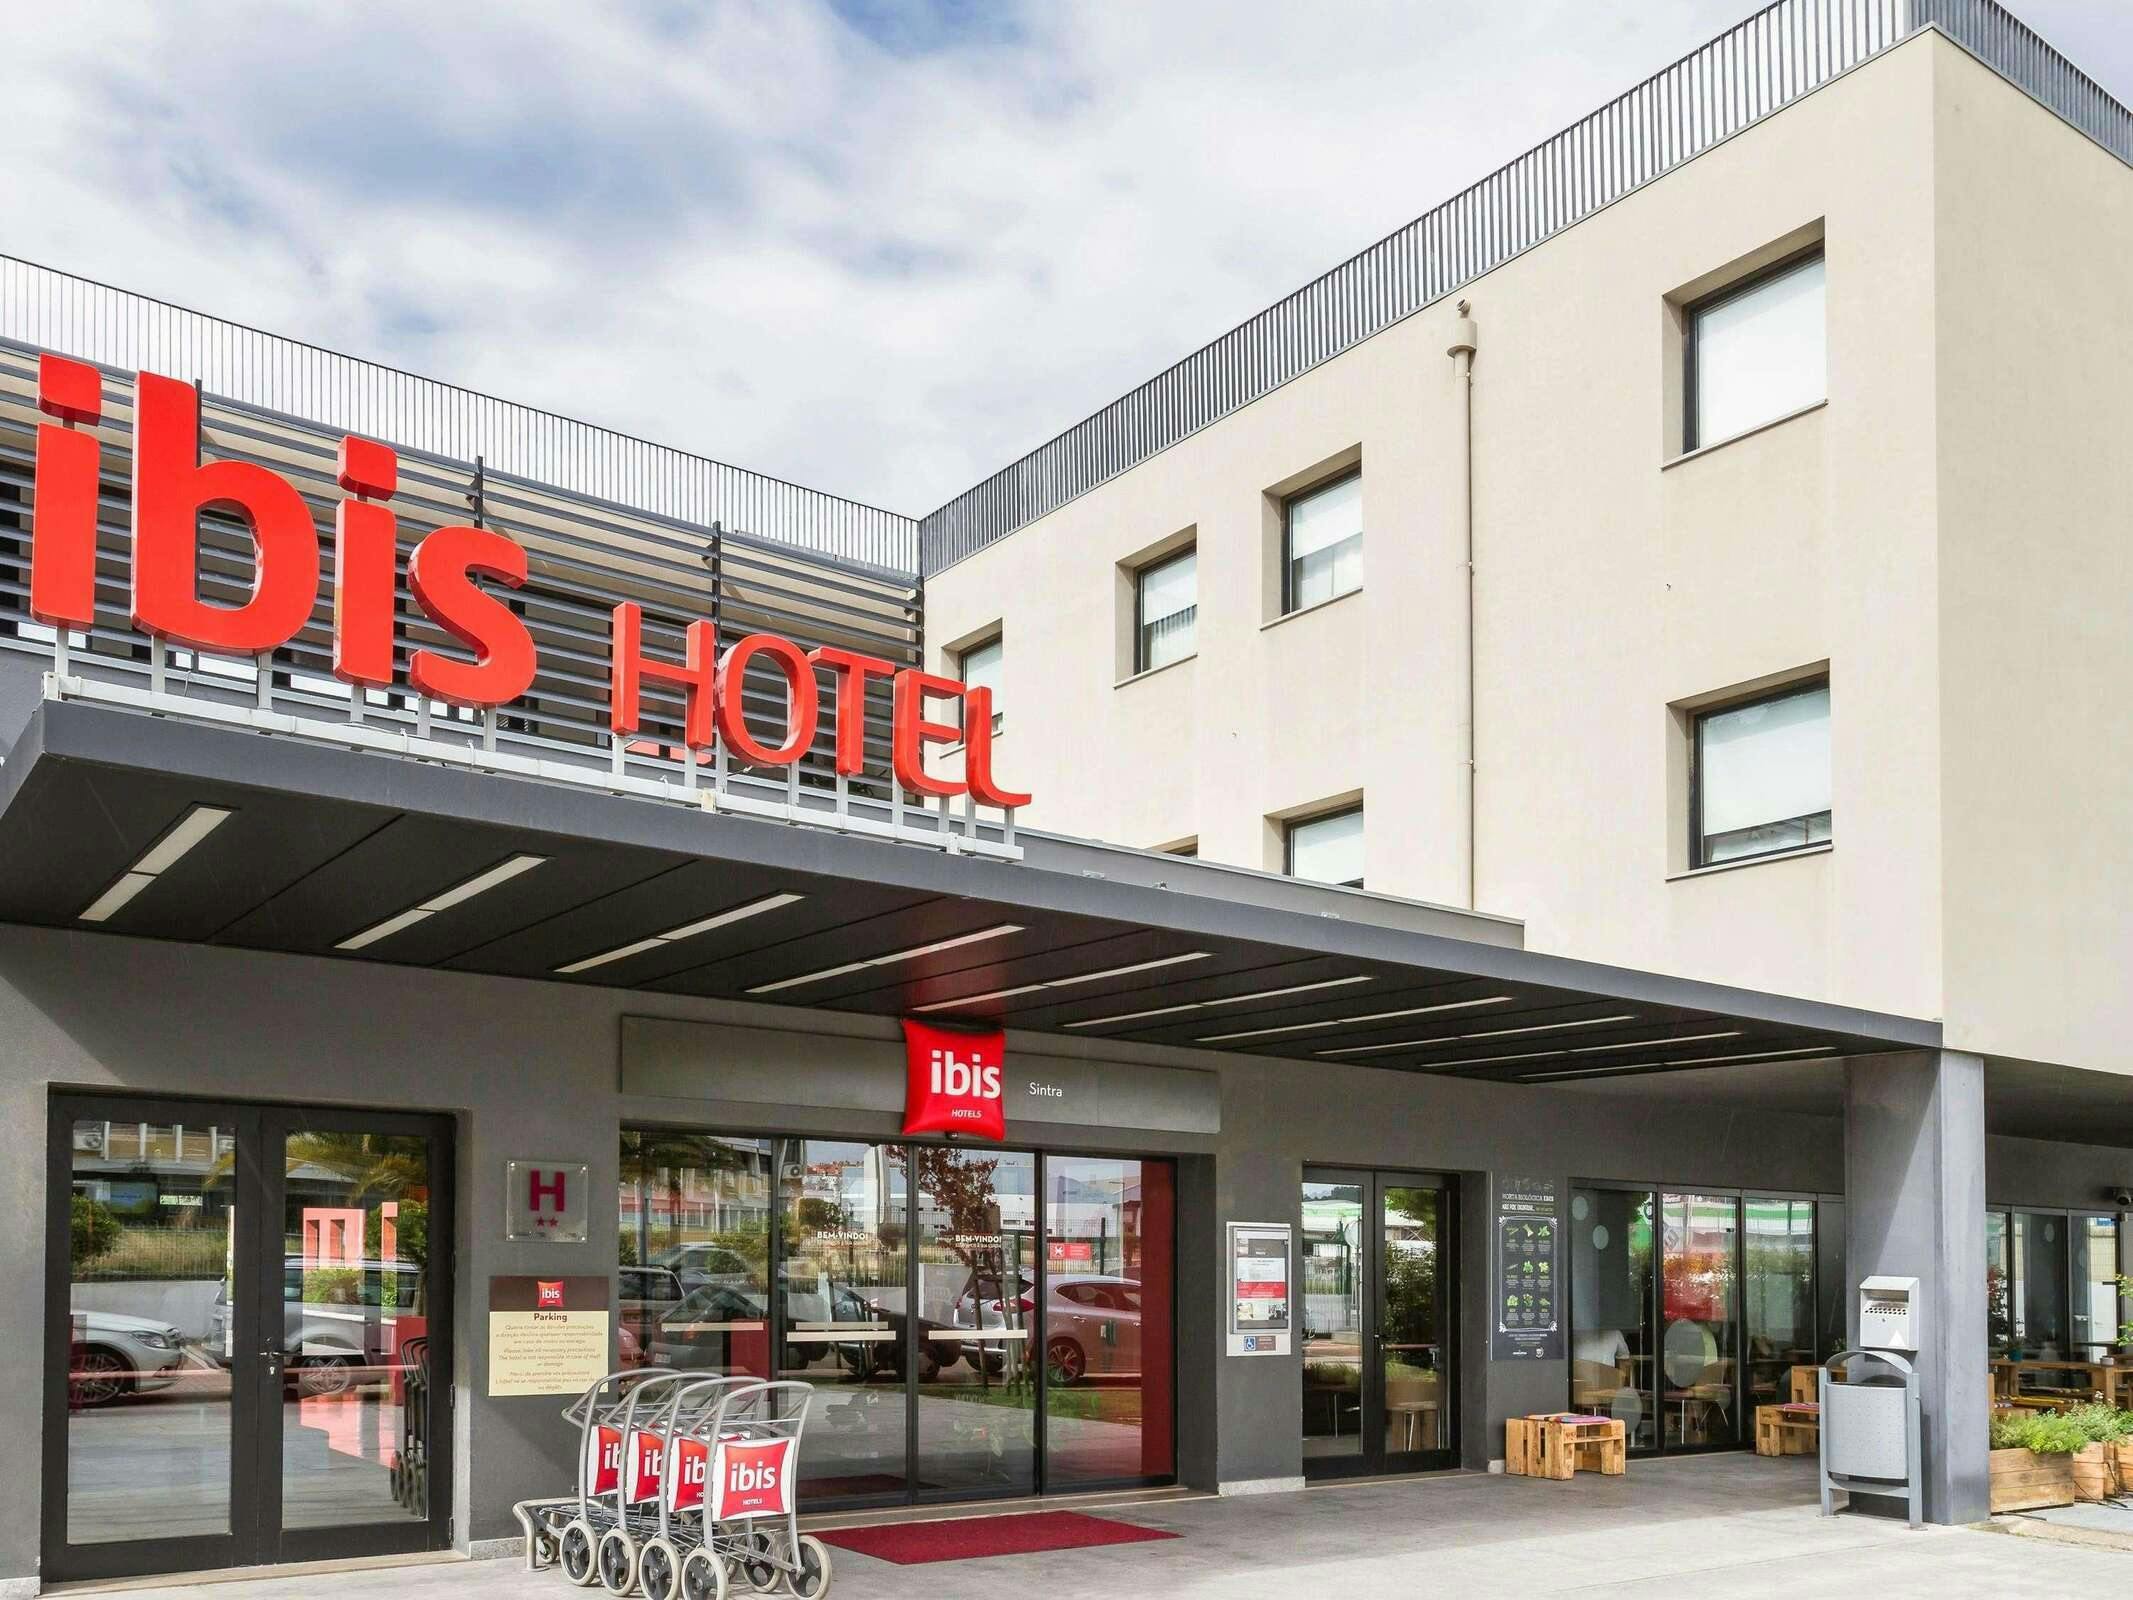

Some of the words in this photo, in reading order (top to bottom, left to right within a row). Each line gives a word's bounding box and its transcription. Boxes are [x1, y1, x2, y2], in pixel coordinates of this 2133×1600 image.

[31, 353, 535, 707] ibis
[612, 601, 1031, 807] HOTEL
[931, 1049, 1001, 1099] ibis
[1029, 1082, 1063, 1097] Sintra
[951, 1109, 982, 1119] HOTELS
[530, 1170, 565, 1212] H
[817, 1231, 868, 1241] BEM-VINDO!
[955, 1234, 1002, 1243] BEM-VINDO!
[541, 1287, 561, 1299] ibis
[533, 1312, 568, 1322] Parking
[604, 1443, 621, 1470] ib
[644, 1449, 664, 1477] ib
[684, 1456, 706, 1485] ib
[730, 1461, 776, 1492] ibis
